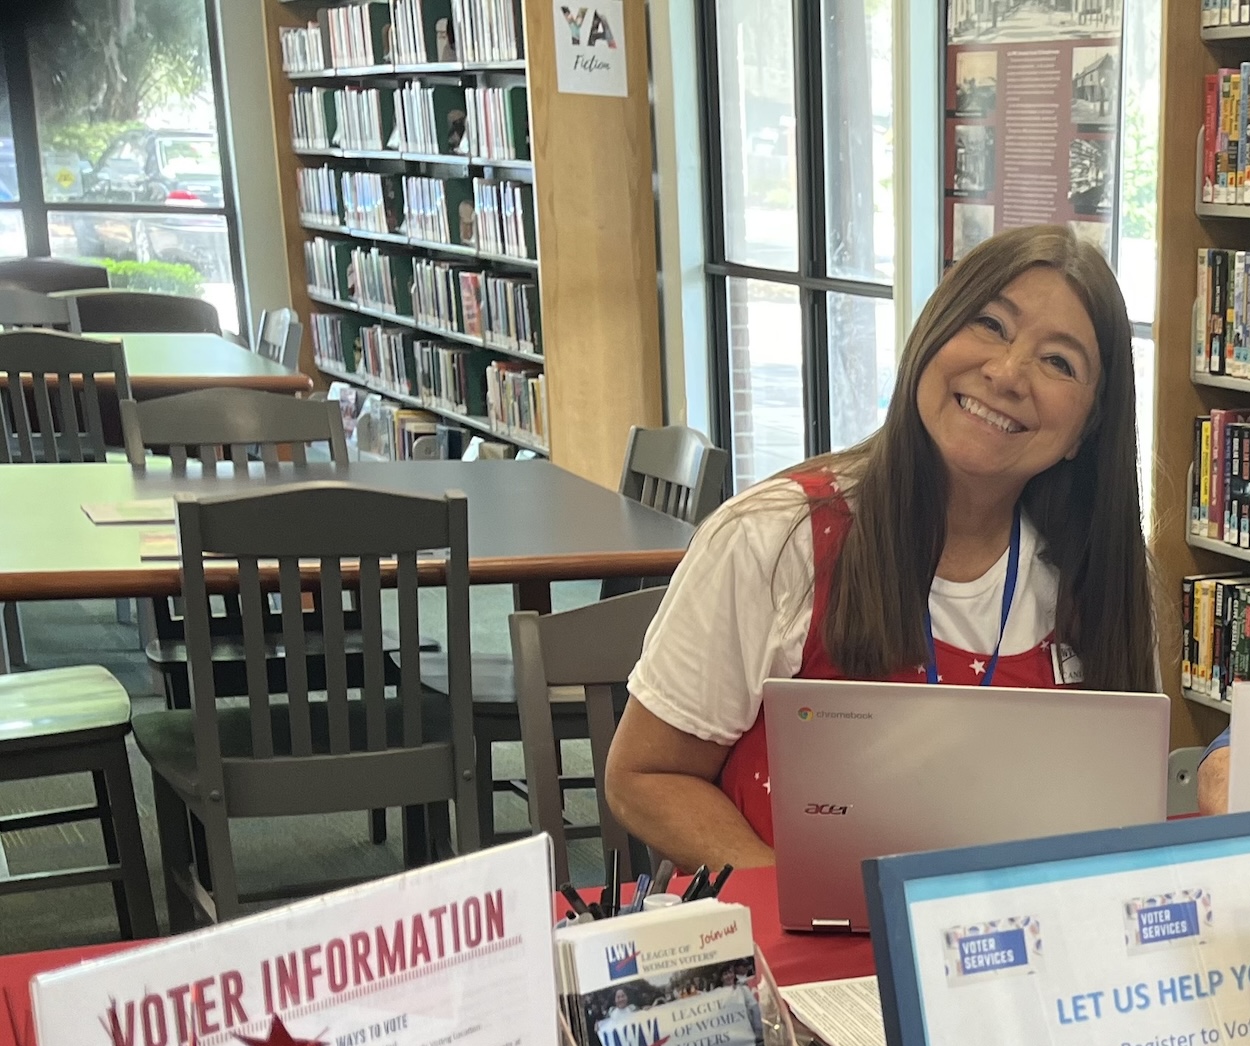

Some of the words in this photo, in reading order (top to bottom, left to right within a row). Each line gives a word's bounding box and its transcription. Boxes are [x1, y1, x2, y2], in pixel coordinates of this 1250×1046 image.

[561, 6, 617, 49] YA
[573, 54, 610, 73] Fiction
[817, 710, 873, 720] chromebook
[805, 803, 851, 815] acer
[1142, 920, 1187, 939] SERVICES
[260, 888, 506, 1014] INFORMATION
[964, 949, 1014, 969] SERVICES
[1057, 992, 1103, 1025] LET
[1114, 983, 1151, 1014] US
[1159, 969, 1223, 1006] HELP
[672, 1000, 725, 1022] LEAGUE
[384, 1013, 408, 1034] VOTE
[674, 1024, 693, 1038] OF
[695, 1009, 745, 1033] WOMEN
